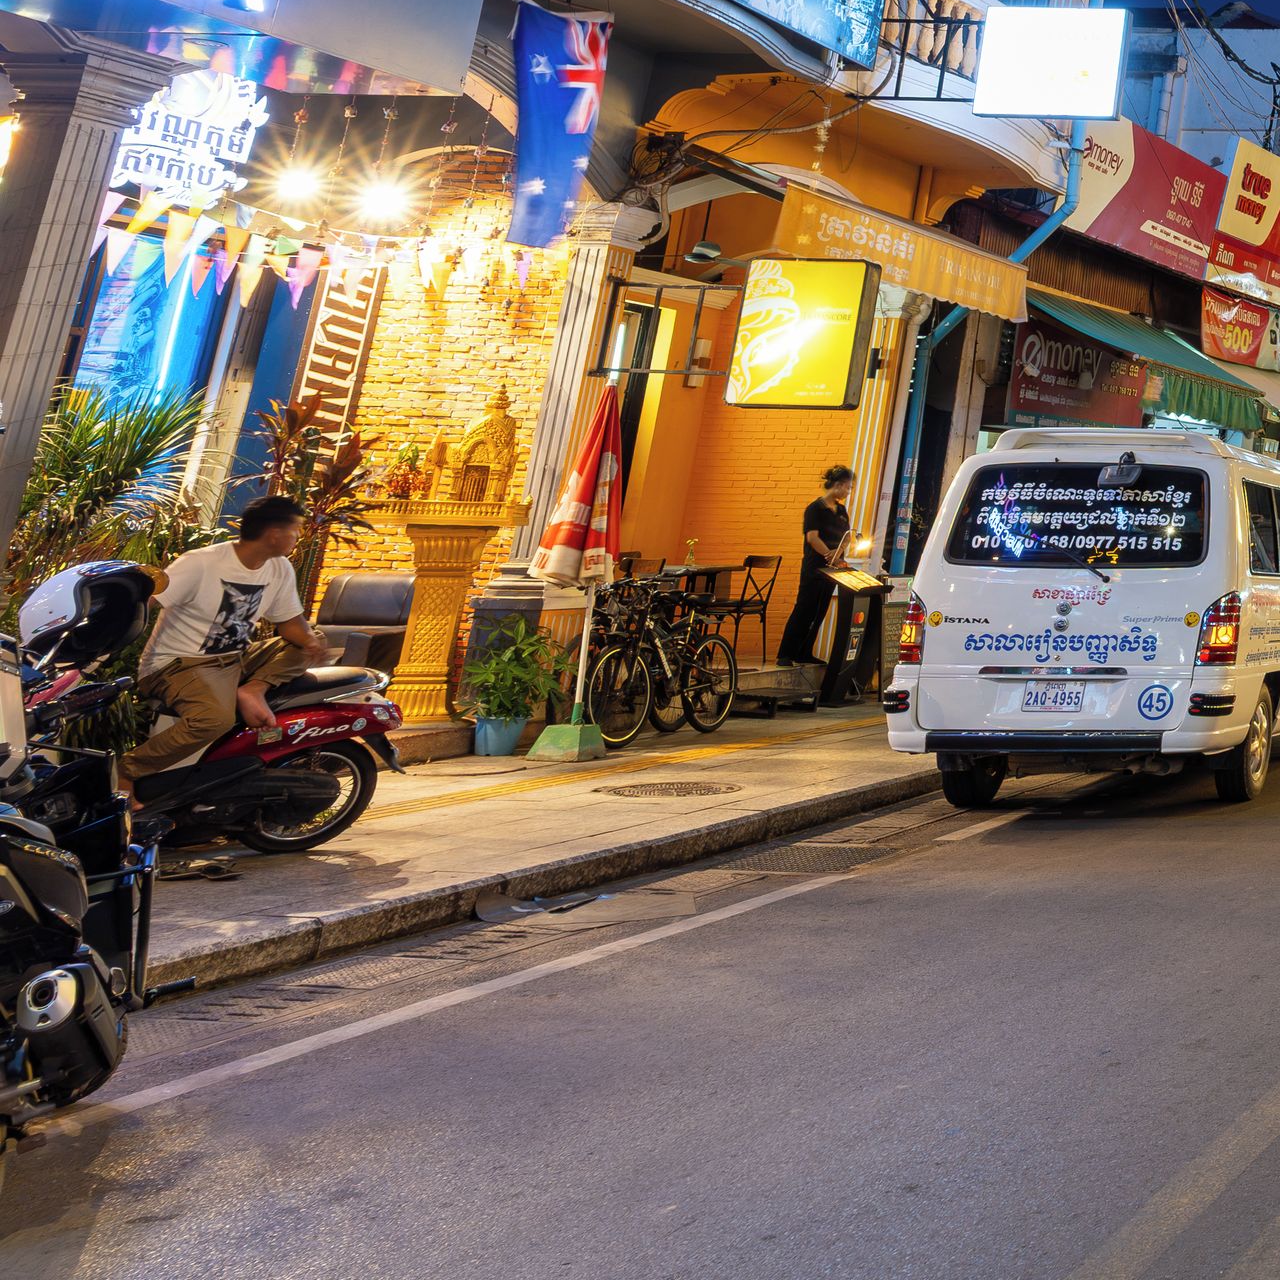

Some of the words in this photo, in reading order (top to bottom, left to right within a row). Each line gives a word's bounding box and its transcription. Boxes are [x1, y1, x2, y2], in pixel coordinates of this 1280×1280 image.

[1241, 162, 1272, 199] true
[1235, 194, 1267, 225] money
[1117, 536, 1147, 550] 515
[1151, 536, 1182, 551] 515
[1024, 691, 1081, 705] 2AQ-4955
[1141, 693, 1167, 712] 45
[291, 724, 350, 744] fino
